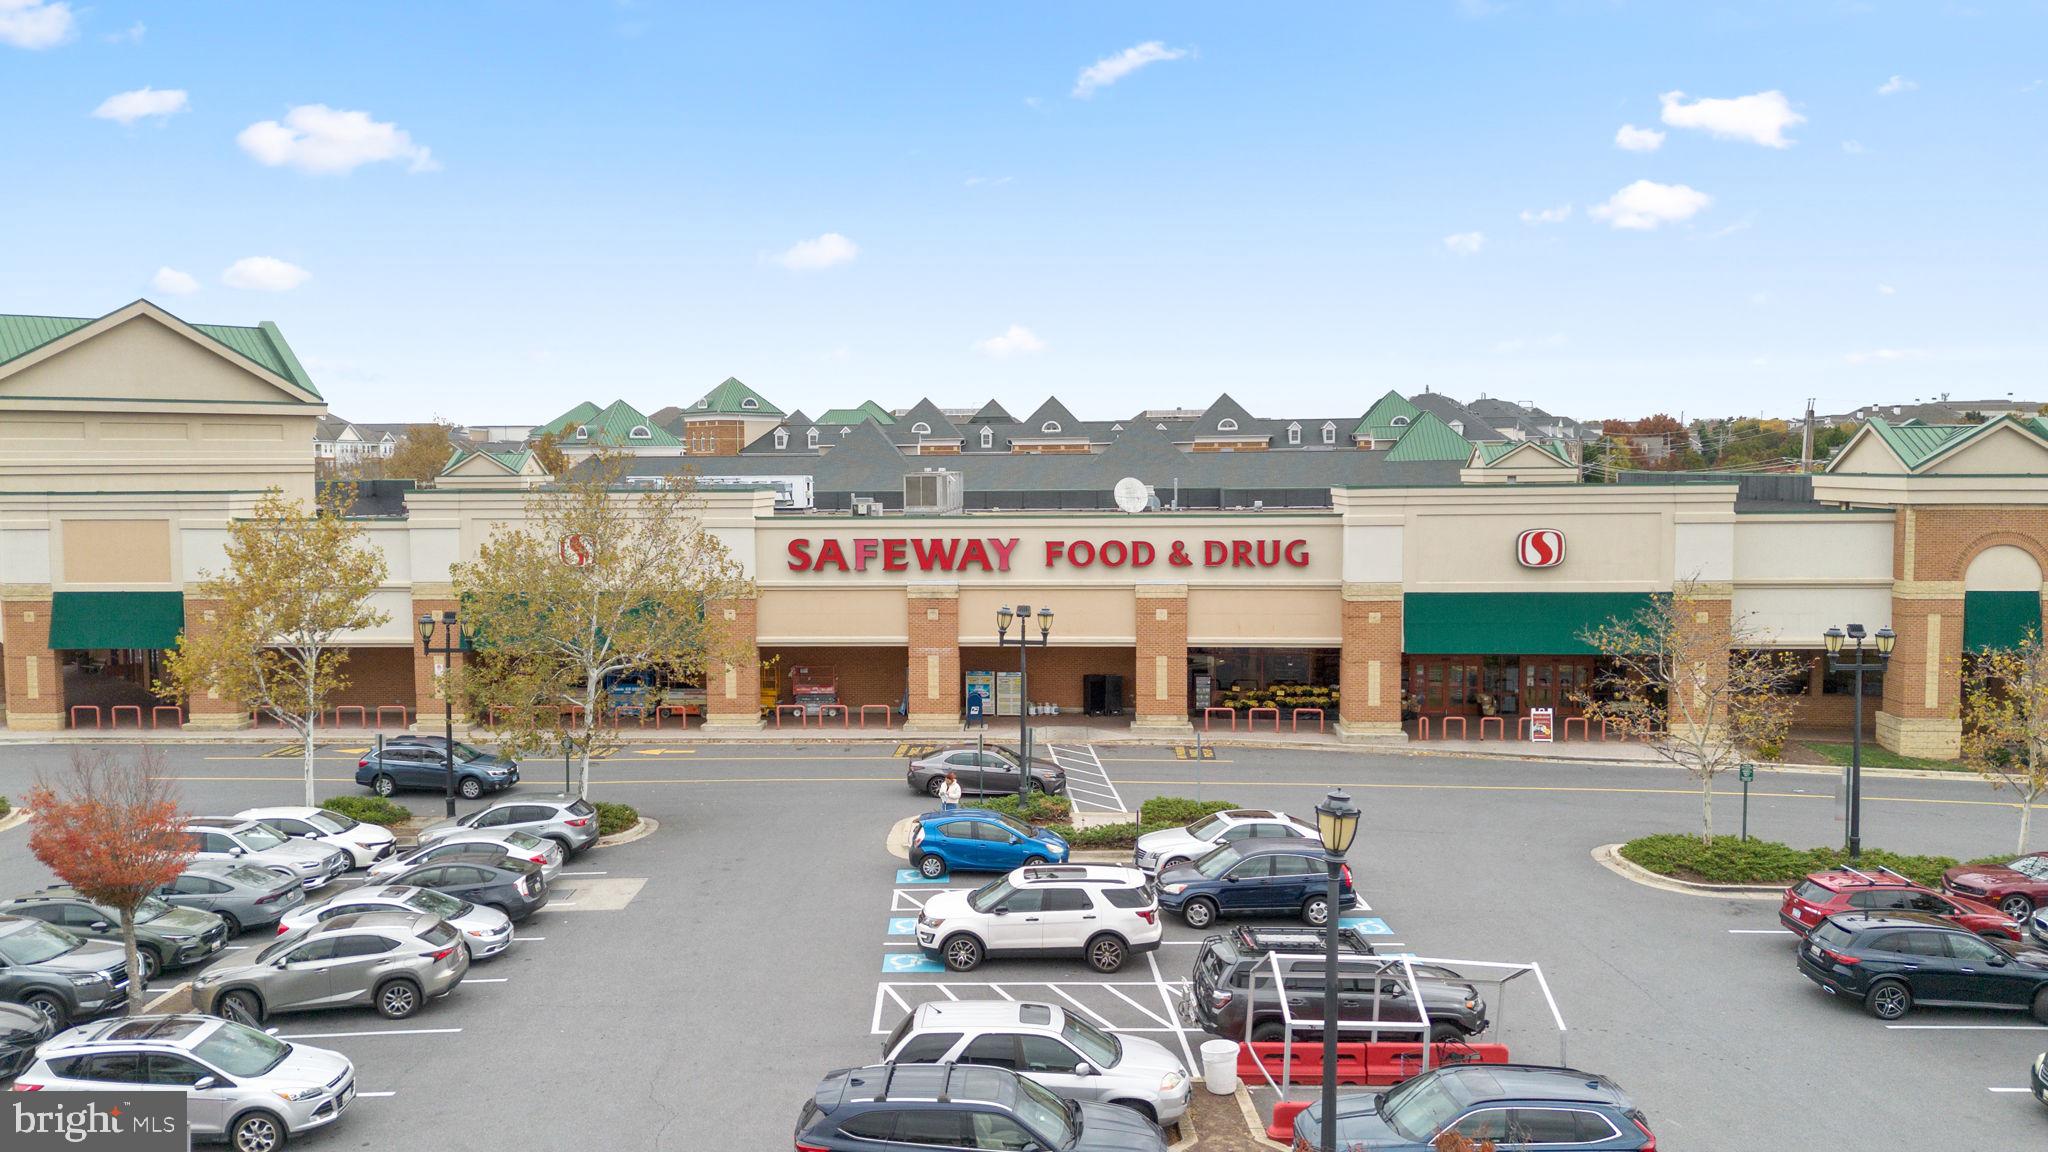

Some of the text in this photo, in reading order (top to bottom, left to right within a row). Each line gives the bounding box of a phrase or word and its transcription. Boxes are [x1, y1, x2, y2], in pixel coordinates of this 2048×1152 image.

[787, 538, 1310, 571] SAFEWAY FOOD & DRUG
